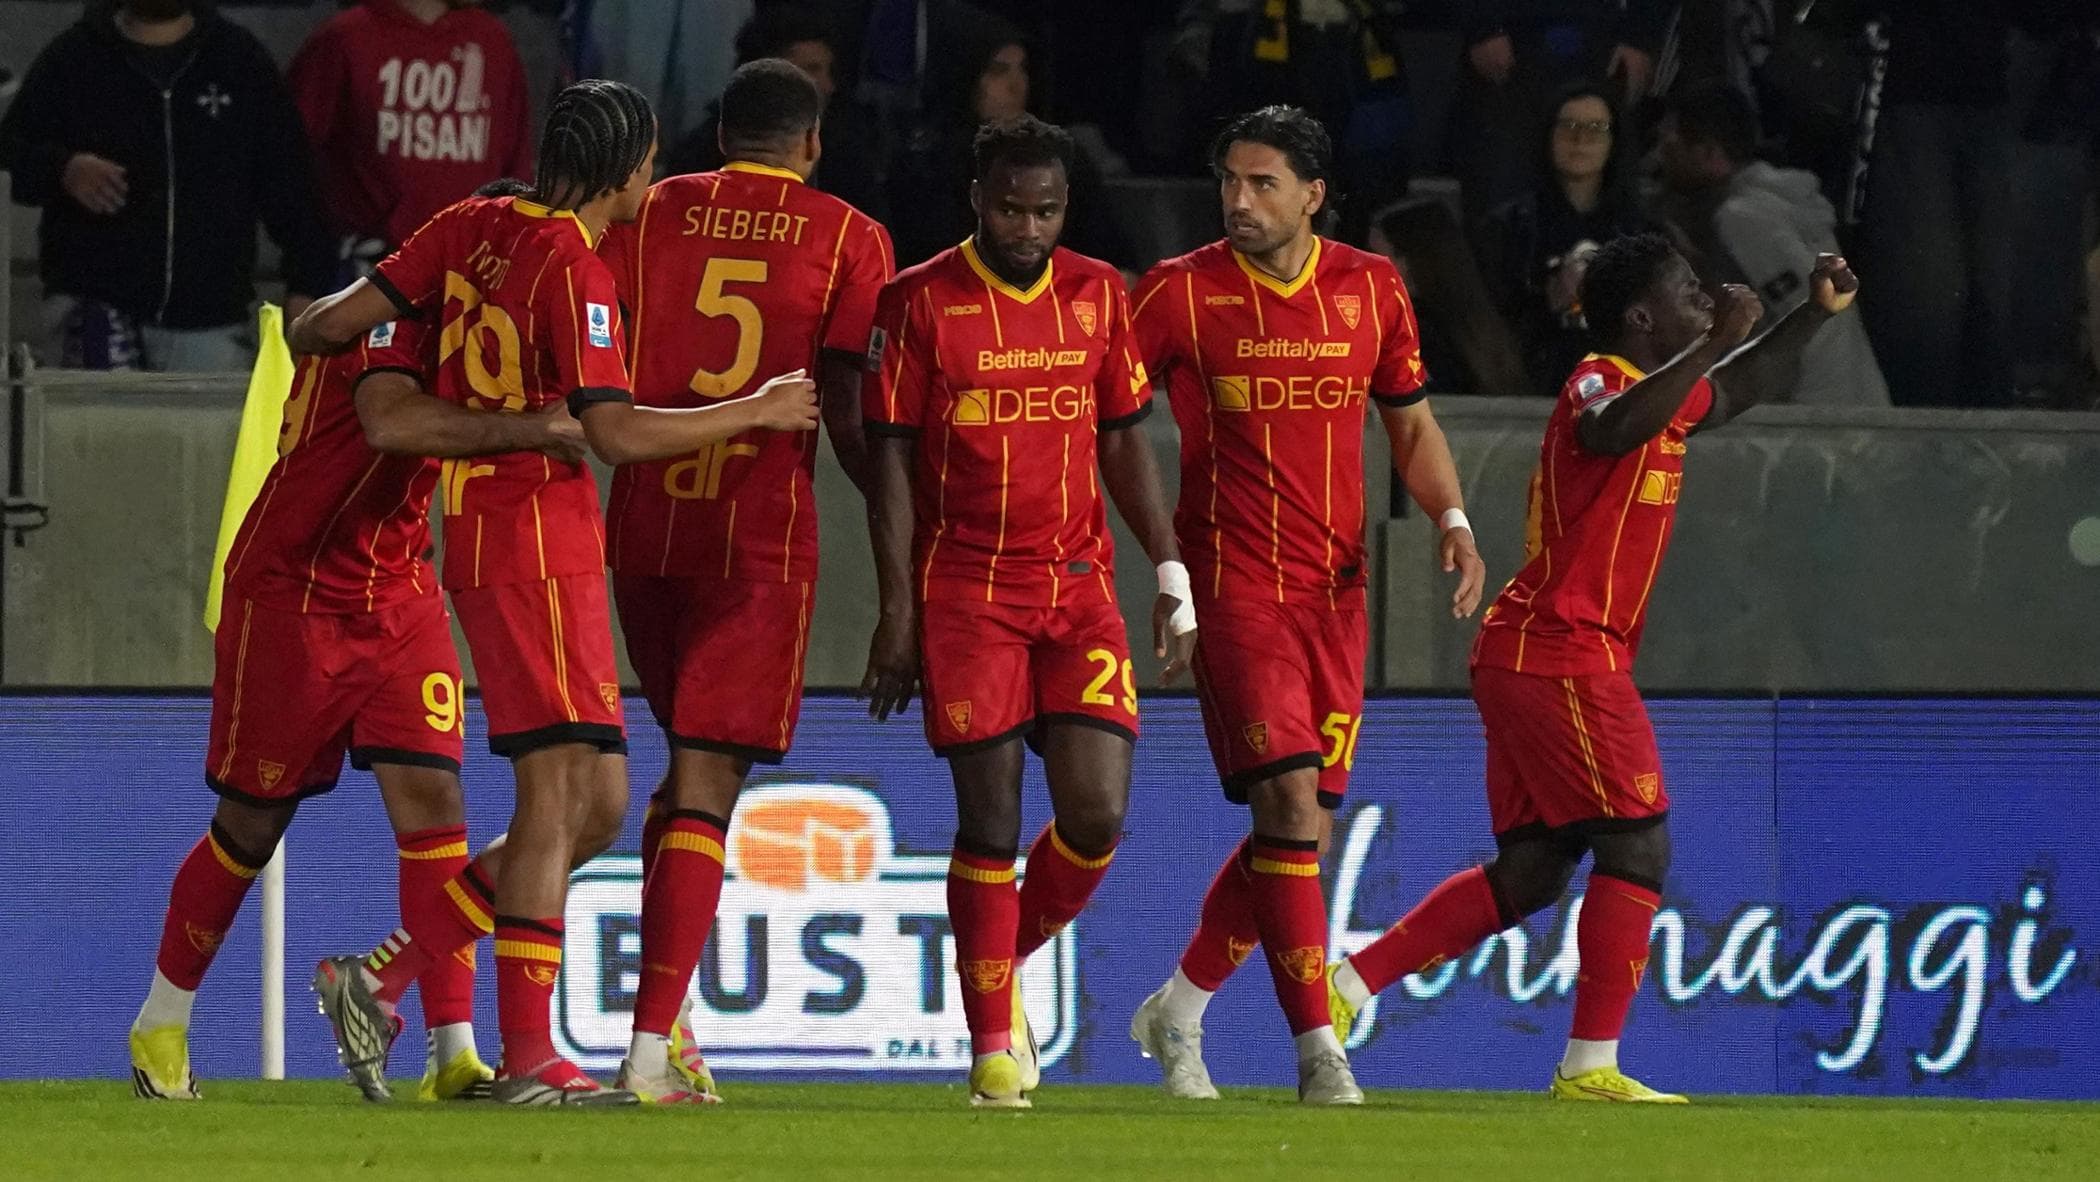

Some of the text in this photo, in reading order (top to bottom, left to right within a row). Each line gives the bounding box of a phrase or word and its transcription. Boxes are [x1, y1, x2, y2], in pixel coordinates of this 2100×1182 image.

[377, 110, 491, 162] PISAN
[682, 206, 809, 245] SIEBERT
[689, 257, 769, 399] 5
[978, 347, 1082, 372] Betitaly PAY
[1237, 338, 1346, 361] Betitaly PAY
